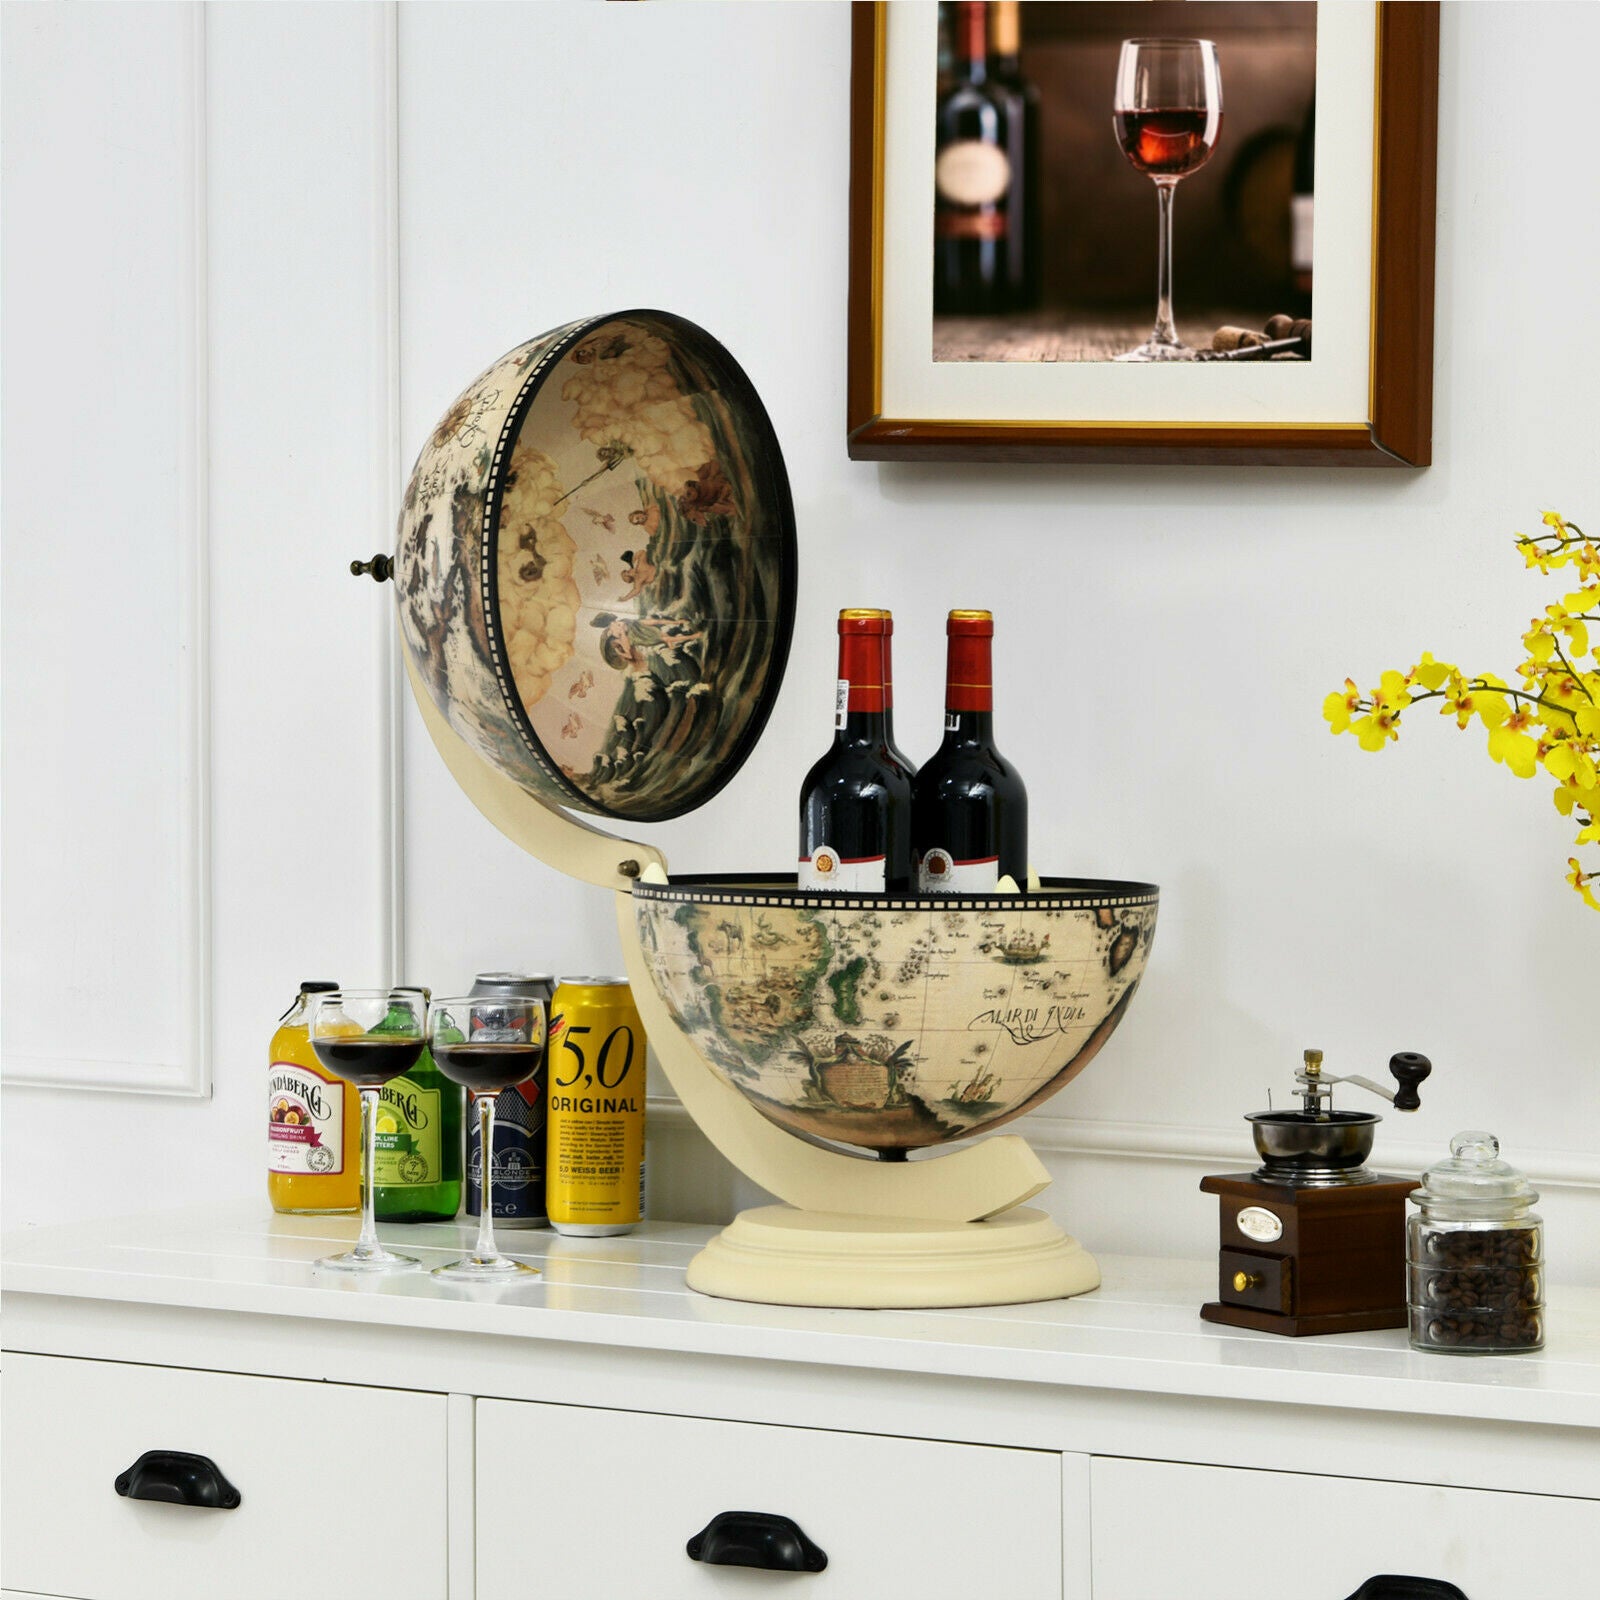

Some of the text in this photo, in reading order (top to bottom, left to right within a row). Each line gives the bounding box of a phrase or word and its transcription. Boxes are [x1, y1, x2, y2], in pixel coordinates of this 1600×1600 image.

[555, 1025, 634, 1090] 5,0
[551, 1095, 639, 1113] ORIGINAL
[571, 1166, 597, 1174] WEISS
